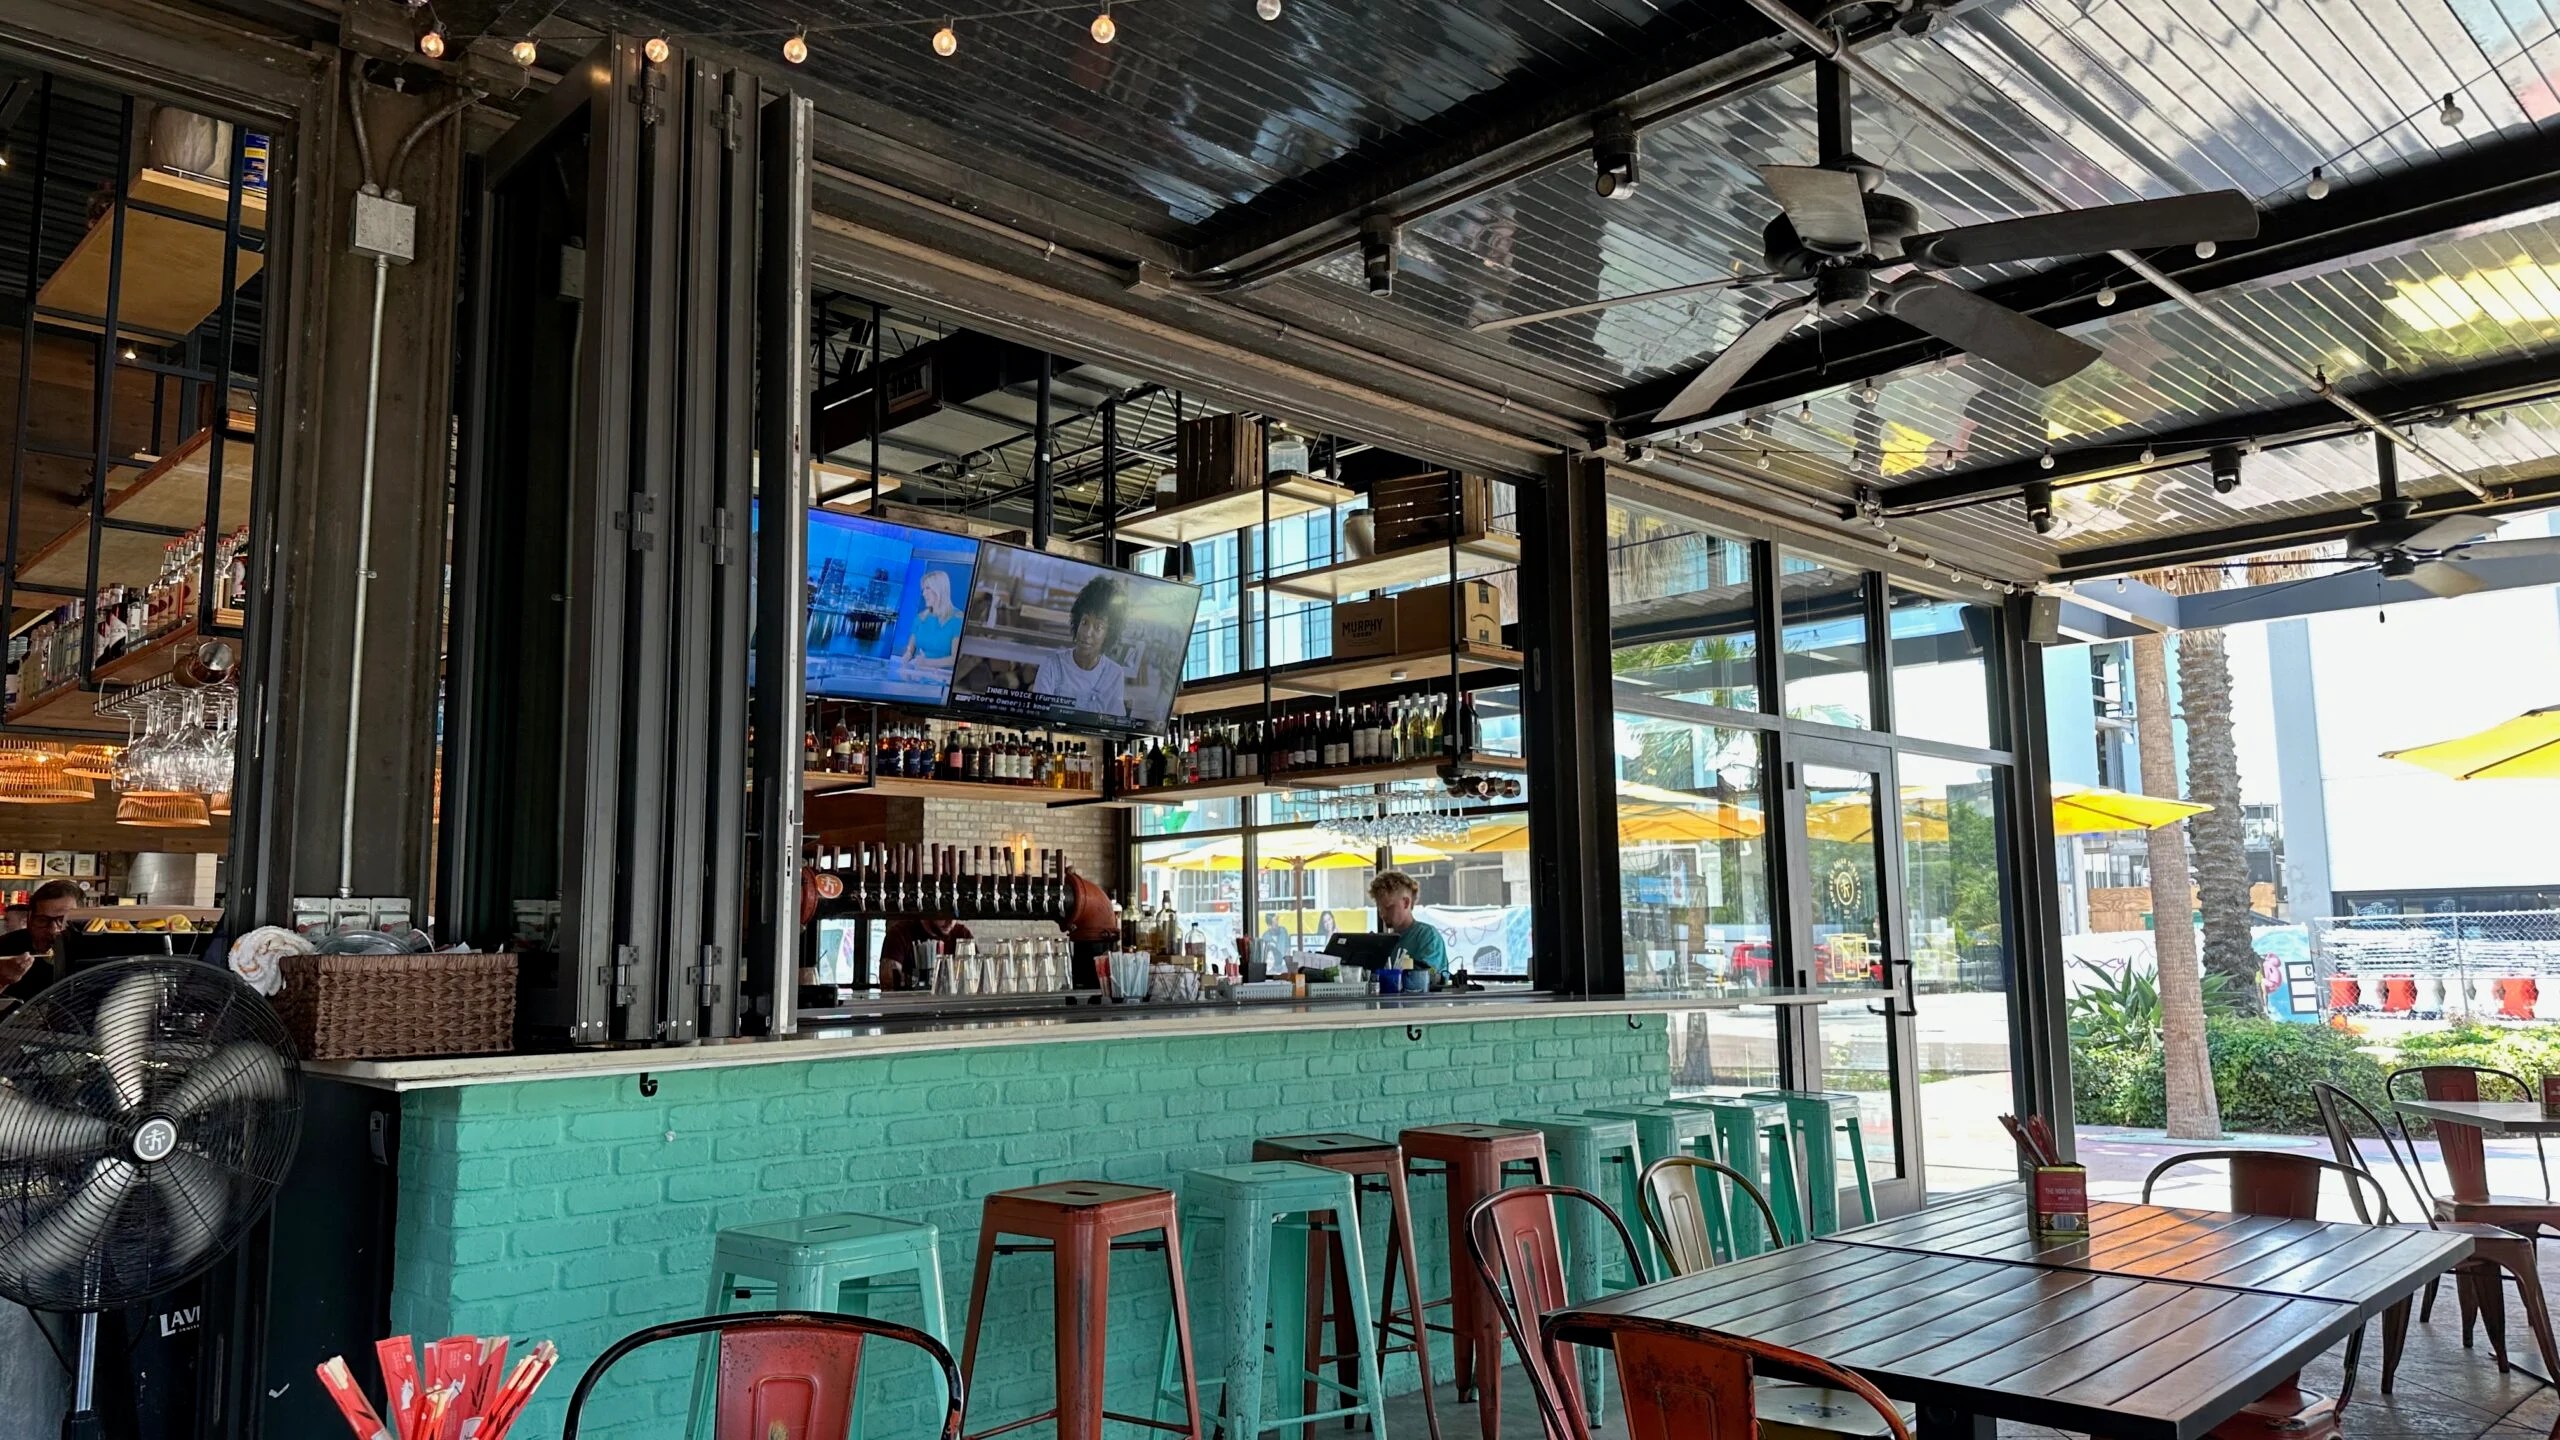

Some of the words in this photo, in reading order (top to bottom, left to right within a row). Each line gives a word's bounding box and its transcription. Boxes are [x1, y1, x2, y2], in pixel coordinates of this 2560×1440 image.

[1342, 617, 1382, 637] MURPHY
[971, 694, 993, 703] Store
[986, 686, 1009, 695] INNER
[1010, 690, 1032, 700] VOICE
[1035, 694, 1076, 706] (Furniture
